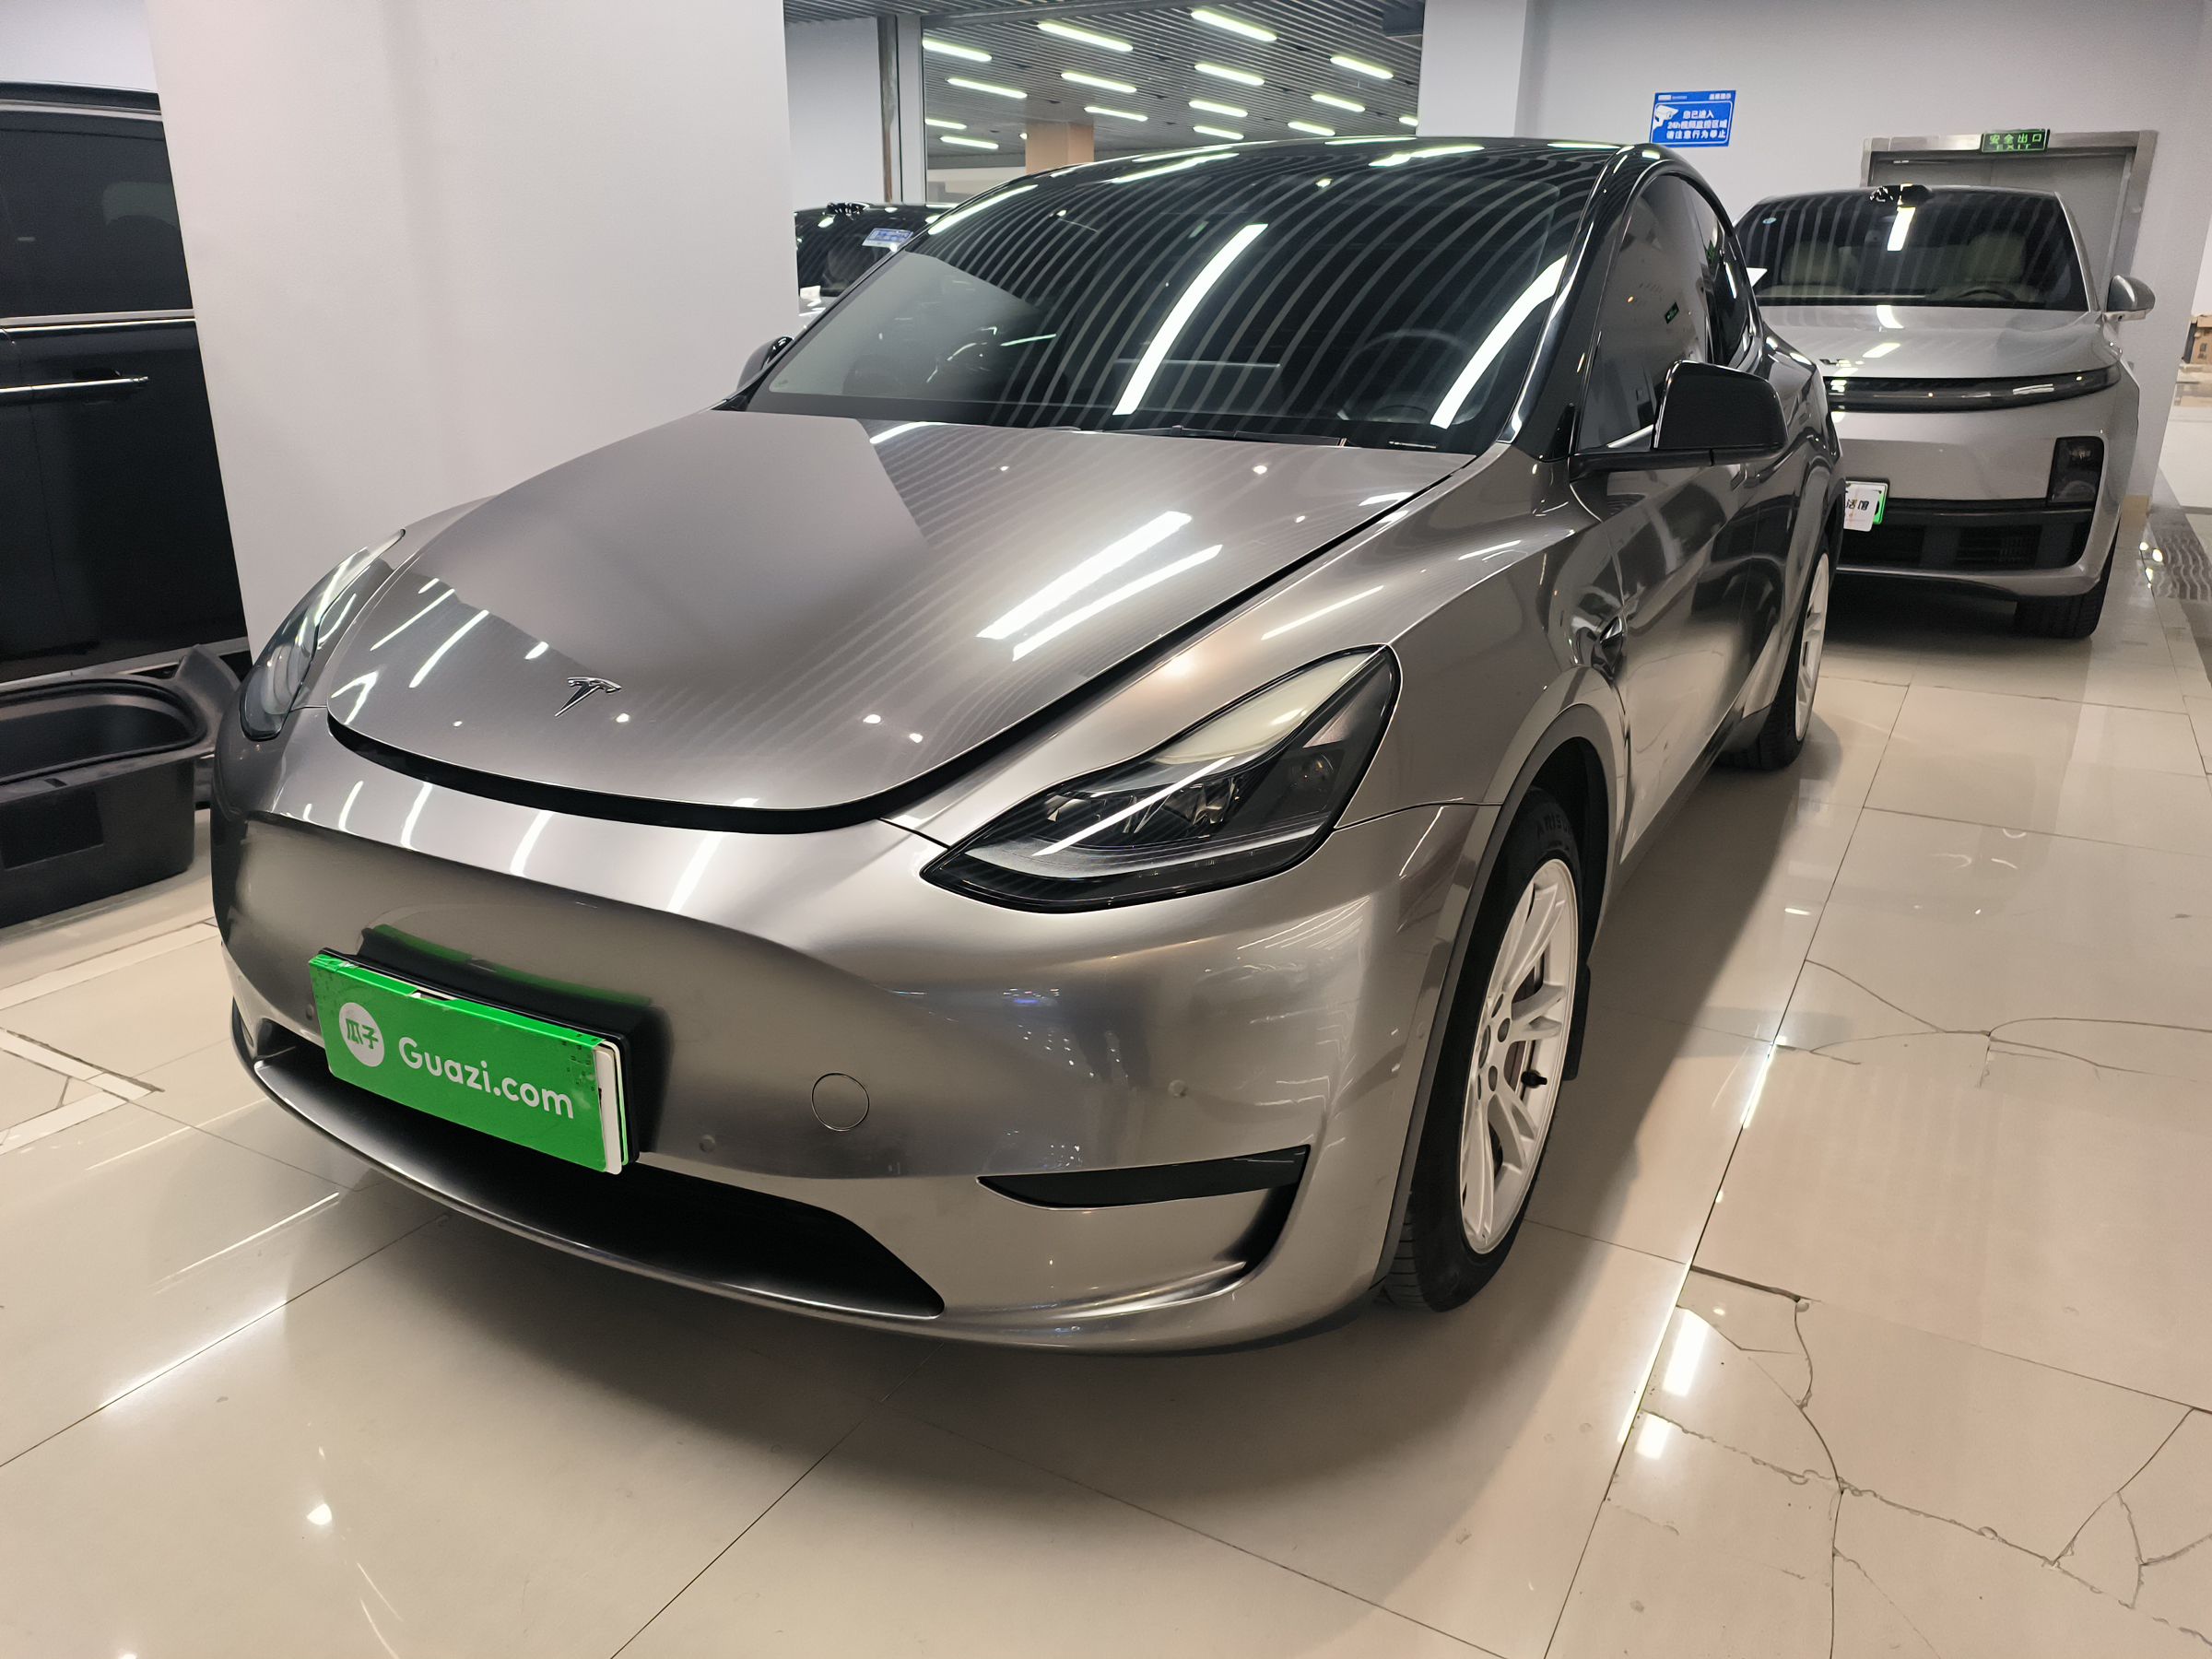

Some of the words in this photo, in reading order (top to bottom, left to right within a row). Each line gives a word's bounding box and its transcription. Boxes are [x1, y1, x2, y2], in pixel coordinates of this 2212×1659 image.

[1990, 134, 2041, 145] 安全出口
[345, 1018, 379, 1050] 瓜子
[398, 1036, 574, 1119] Guazi.com
